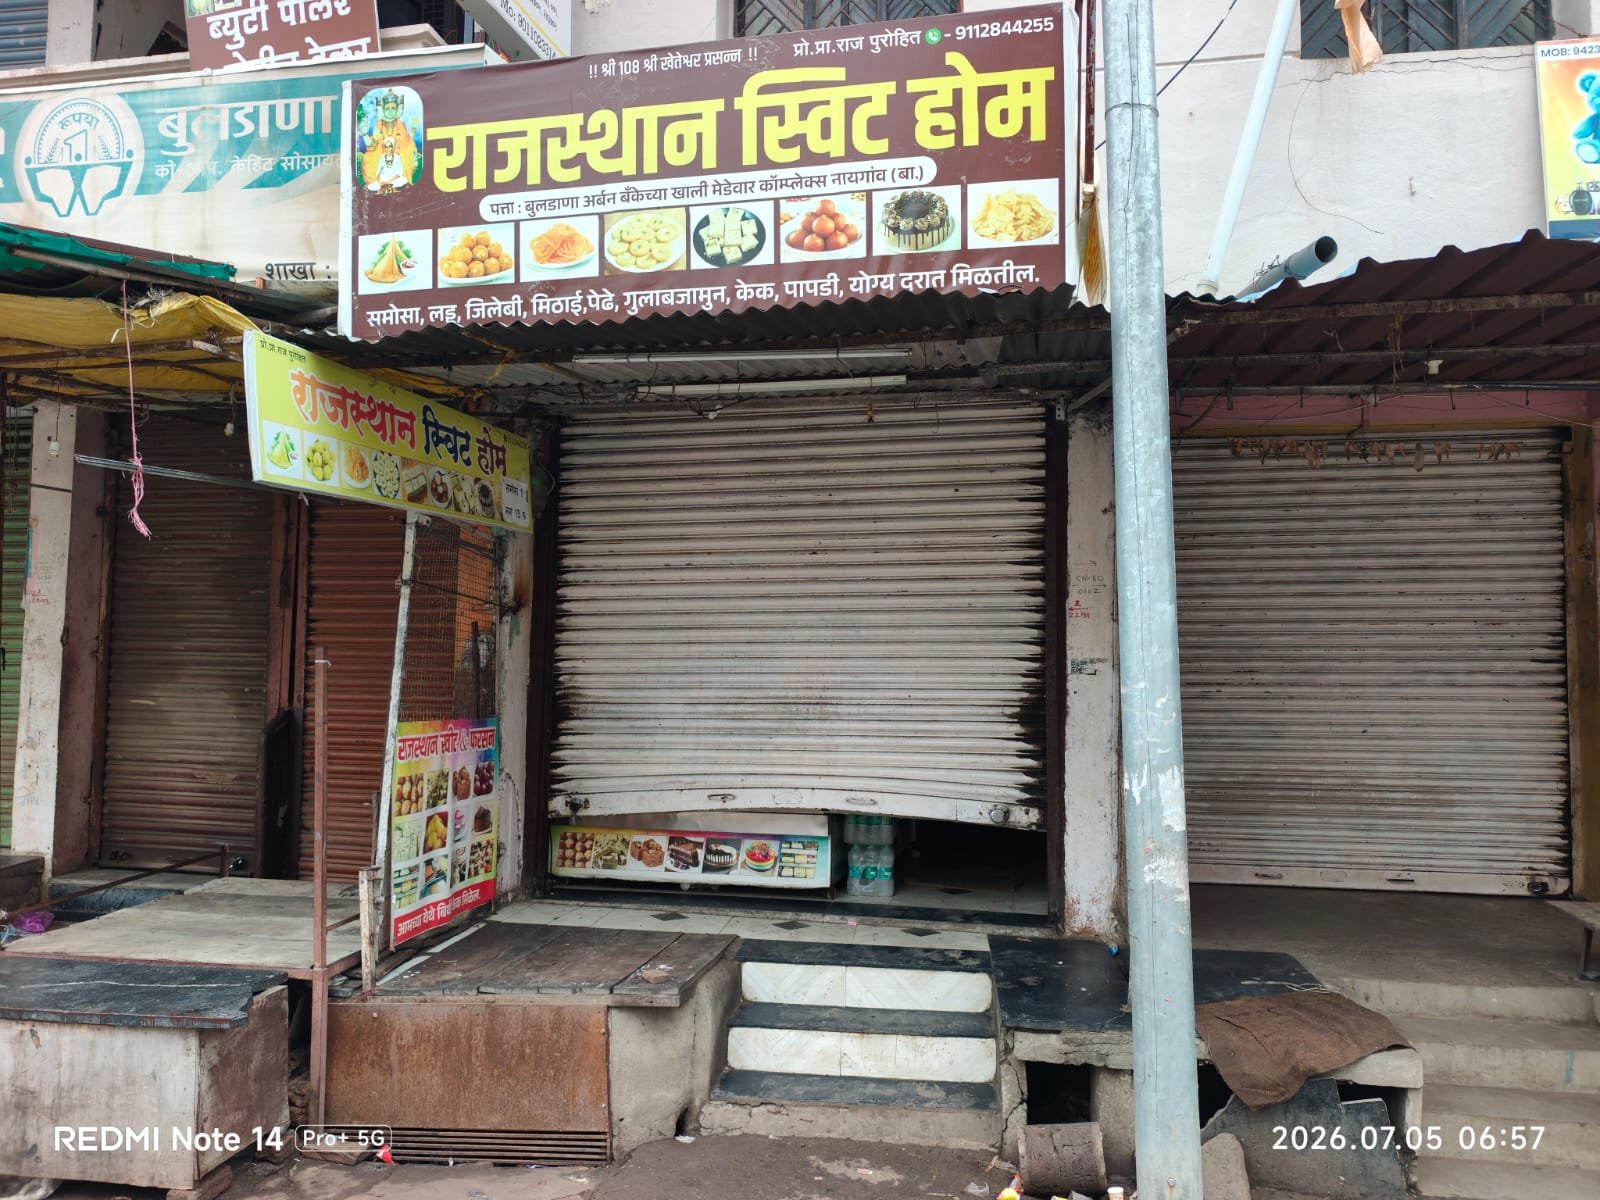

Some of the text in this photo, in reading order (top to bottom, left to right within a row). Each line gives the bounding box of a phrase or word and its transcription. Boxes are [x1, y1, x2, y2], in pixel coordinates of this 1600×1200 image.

[869, 28, 922, 53] पुरोहित
[955, 17, 1054, 40] 9112844255
[1541, 47, 1571, 57] MOB:
[601, 57, 616, 77] श्री
[618, 59, 640, 76] 108
[643, 54, 658, 72] श्री
[660, 52, 702, 70] खेतेश्वर
[703, 48, 742, 67] प्रसन्न
[154, 95, 339, 157] बुलडाणा
[426, 52, 1055, 193] राजस्थान स्विट होम
[489, 201, 514, 216] पत्ता
[524, 196, 580, 217] बुलडाणा
[583, 189, 617, 208] अर्बन
[620, 186, 667, 203] बँकेच्या
[671, 180, 708, 199] खाली
[711, 178, 755, 197] मेडेवार
[759, 173, 827, 193] कॉम्प्लेक्स
[831, 166, 886, 186] नायगांव
[265, 262, 317, 281] शाखा
[367, 304, 425, 328] समोसा,
[464, 294, 528, 320] जिलेबी,
[622, 285, 731, 316] गुलाबजामुन,
[735, 278, 780, 302] केक,
[784, 272, 844, 299] पापडी,
[848, 270, 896, 295] योग्य
[899, 269, 946, 292] दरात
[951, 259, 1040, 287] मिळतील.
[289, 369, 507, 476] राजस्थान स्विट होम
[397, 734, 439, 761] राजस्थान
